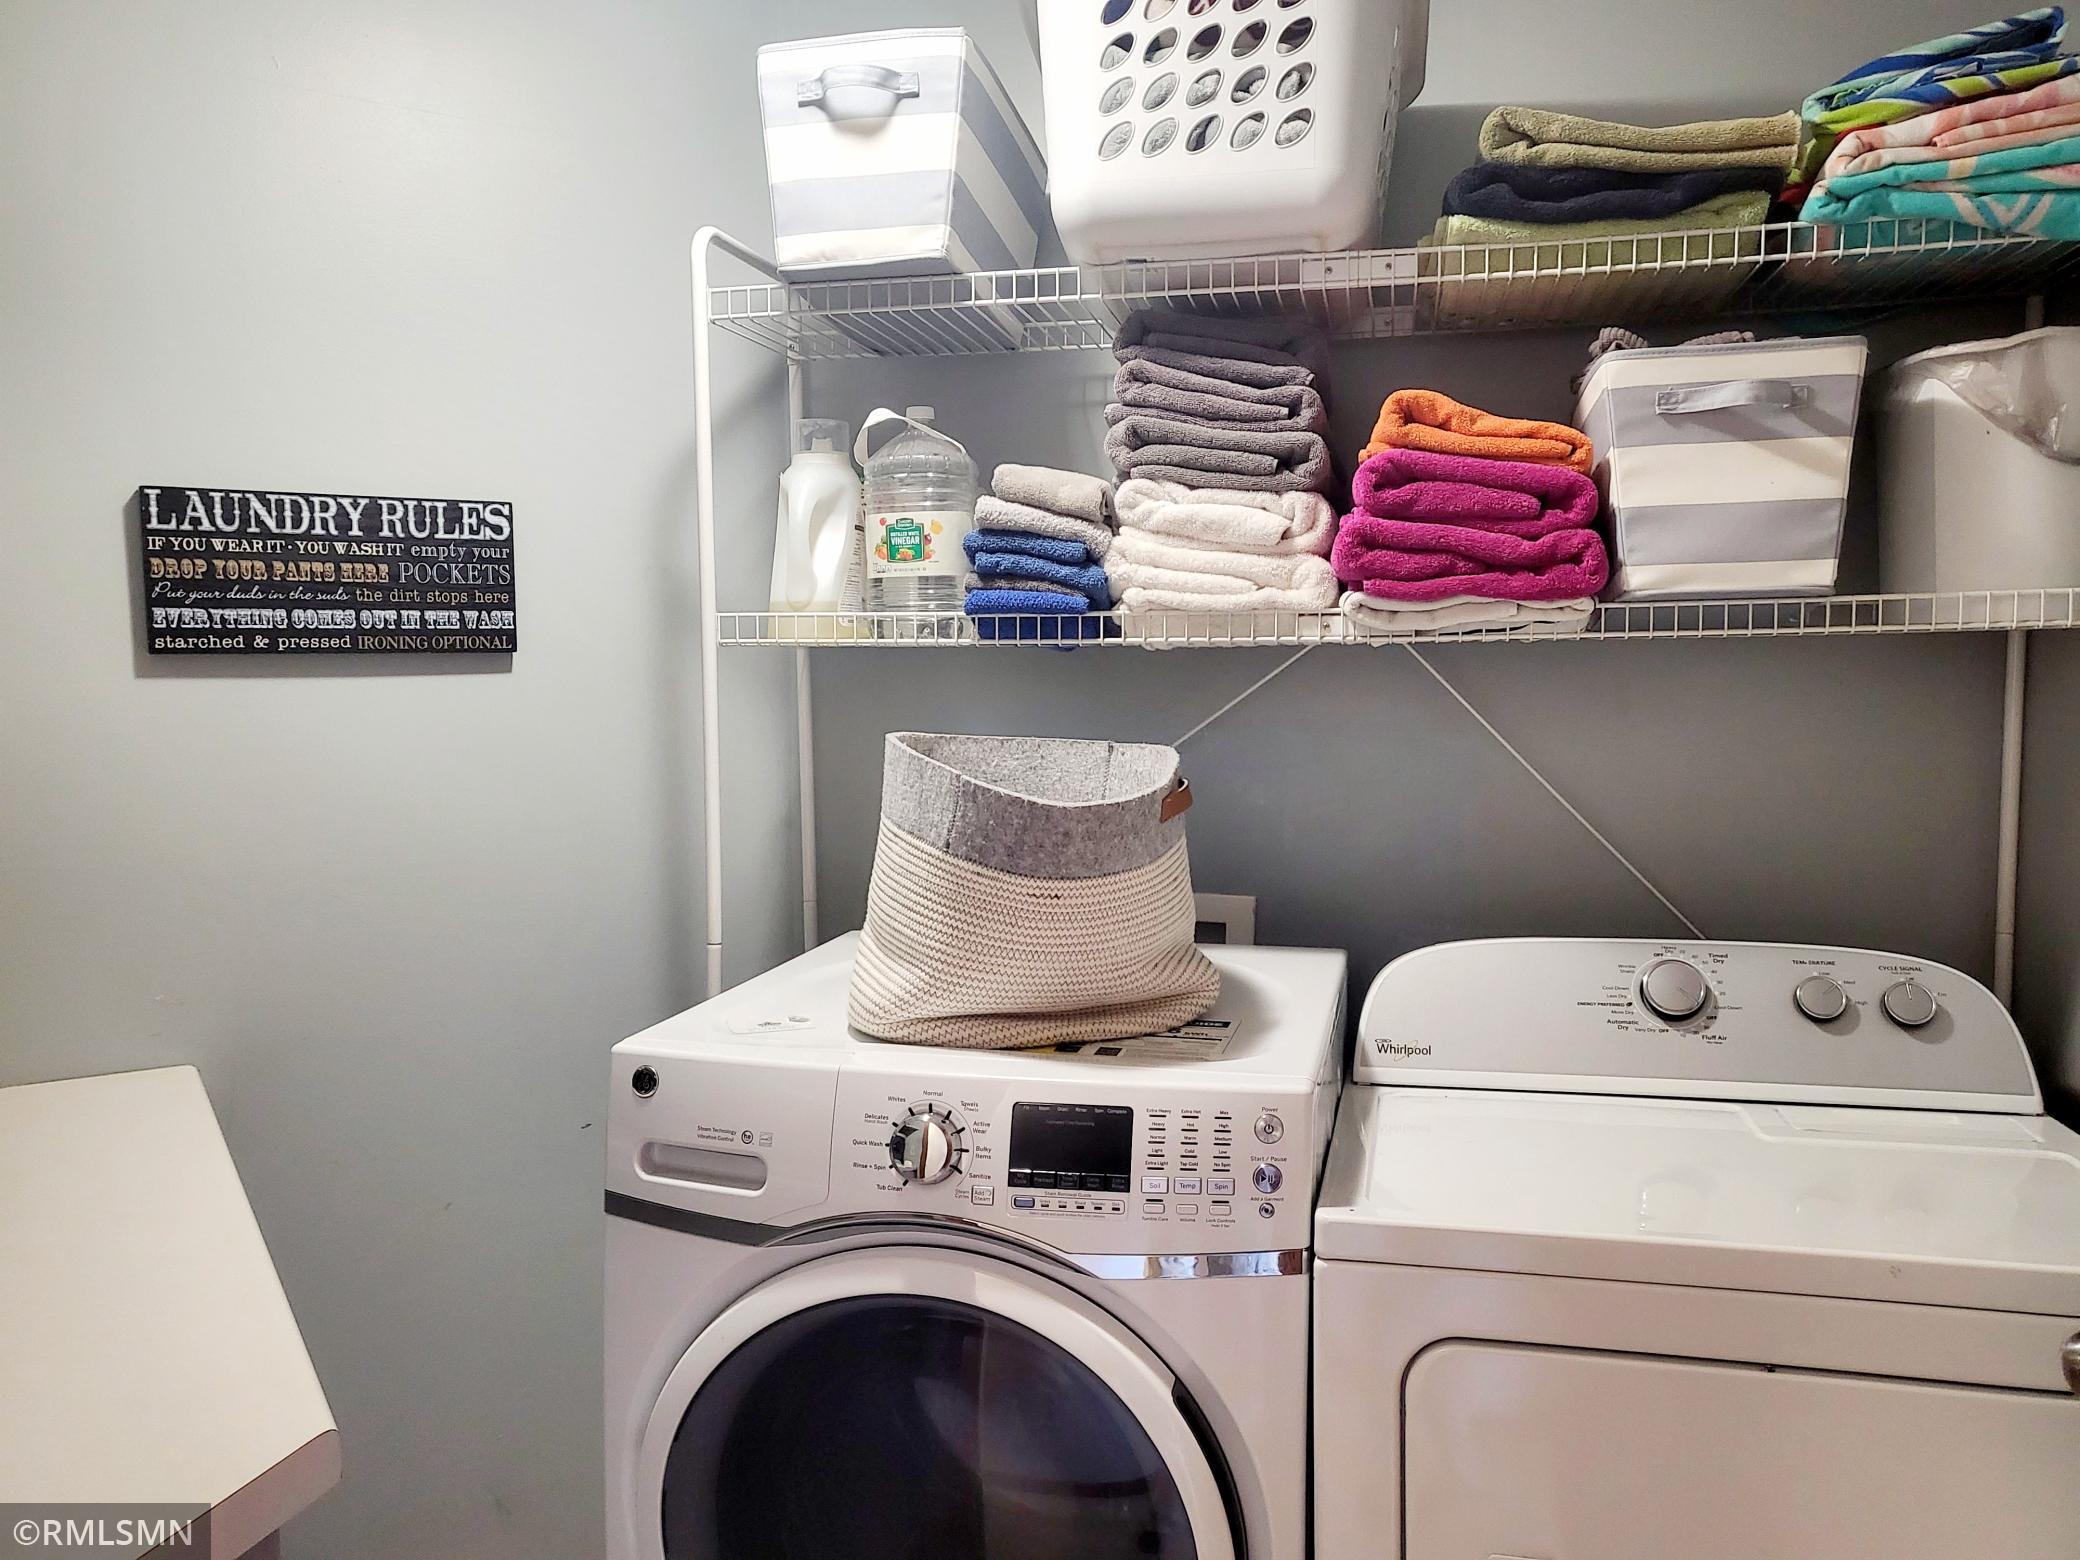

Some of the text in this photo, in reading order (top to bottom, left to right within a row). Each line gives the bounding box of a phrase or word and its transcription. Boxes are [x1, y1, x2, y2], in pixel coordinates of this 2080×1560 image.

[143, 488, 512, 541] LAUNDRY RULES
[147, 536, 405, 557] IF YOU WEAR IT YOU WASH IT
[890, 536, 920, 545] VINEGAR
[410, 540, 510, 562] empty your
[149, 557, 390, 583] DROP YOUR PANTS HERE
[397, 562, 512, 585] POCKETS
[151, 581, 351, 604] Put your duds in the suds
[355, 587, 510, 605] the dirt stops here
[151, 607, 515, 630] EVERYTHING COMES OUT IN THE WASH
[154, 634, 351, 651] starched & pressed
[357, 635, 512, 650] IRONING OPTIONAL
[1606, 1018, 1640, 1026] Automatic
[1376, 1043, 1432, 1058] Whirlpool
[922, 1089, 944, 1097] Normal
[864, 1112, 889, 1120] Delicates
[973, 1120, 991, 1128] Active
[852, 1138, 883, 1147] Quick Wash
[873, 1163, 887, 1171] Spin
[876, 1183, 903, 1192] Tub Clean
[1179, 1182, 1197, 1191] Temp
[1214, 1183, 1229, 1191] Spin
